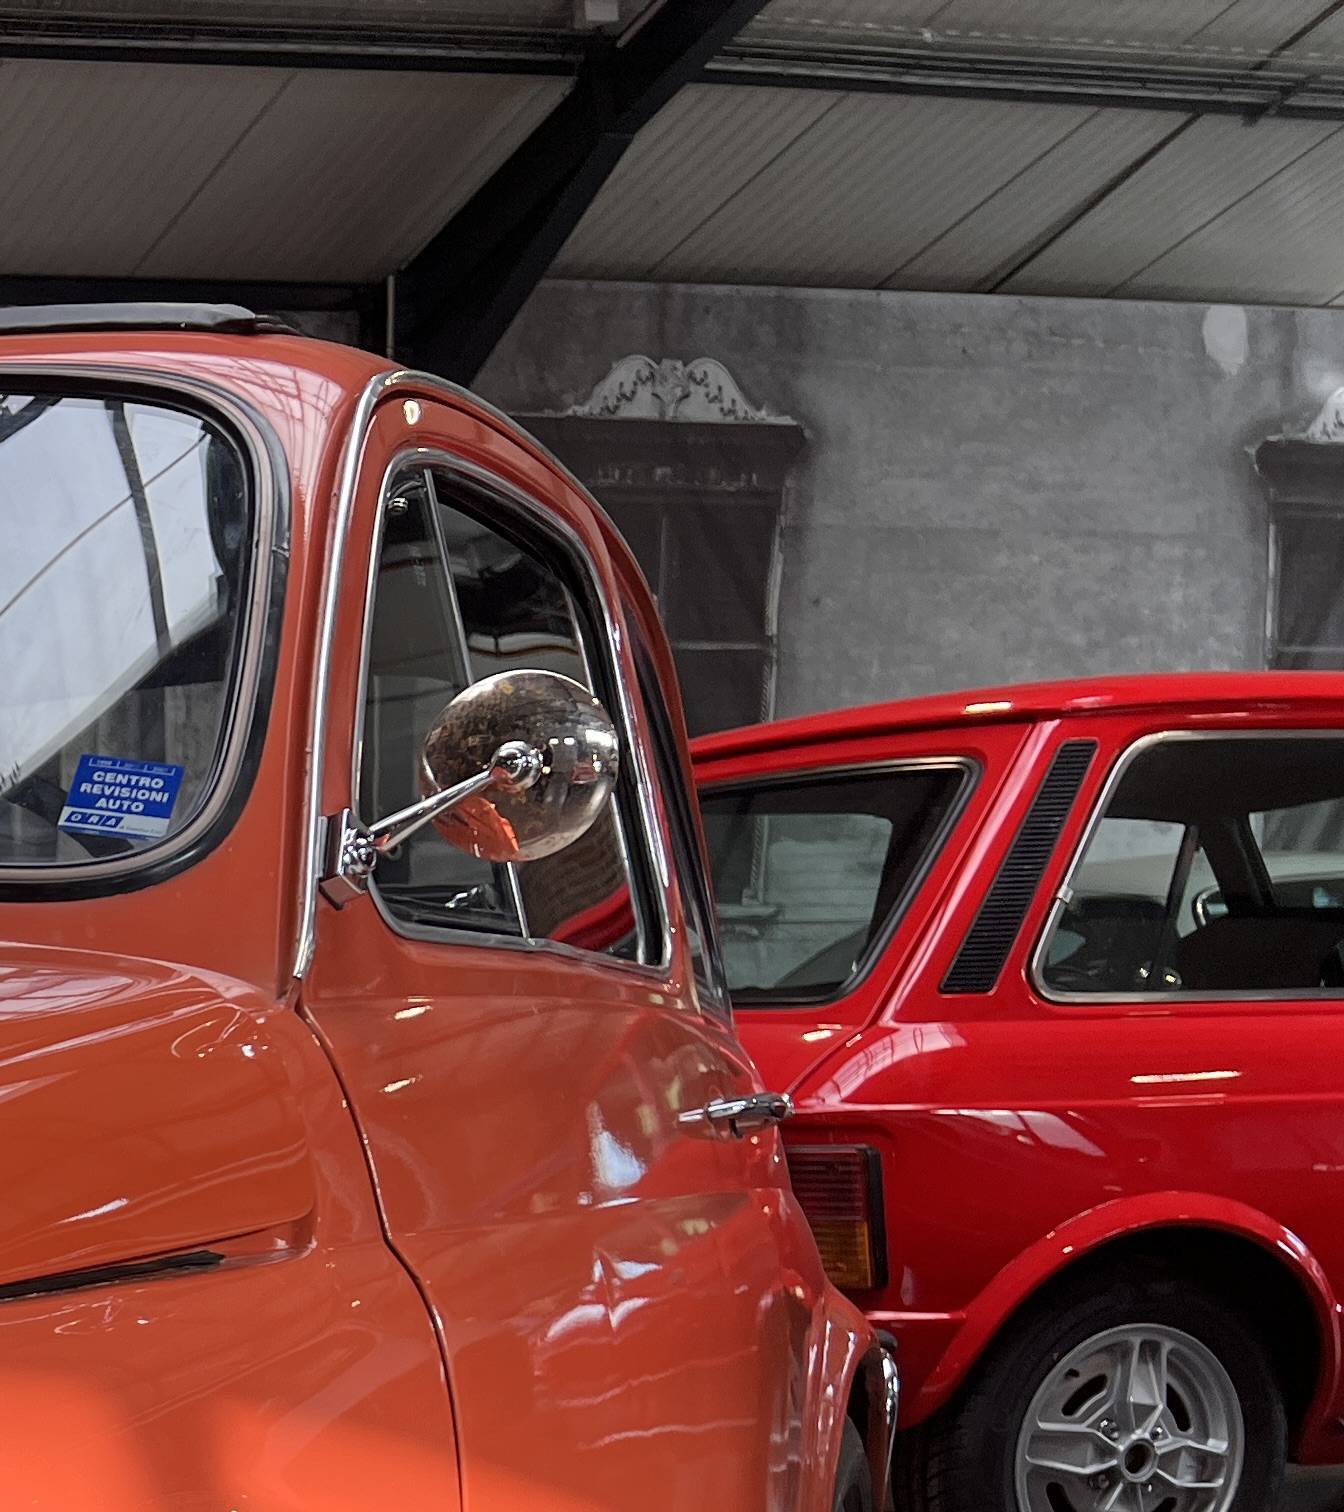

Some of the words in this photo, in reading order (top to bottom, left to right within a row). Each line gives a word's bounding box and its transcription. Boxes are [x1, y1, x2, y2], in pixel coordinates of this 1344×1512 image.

[92, 771, 164, 788] CENTRO
[79, 782, 169, 803] REVISIONI
[95, 798, 144, 812] AUTO
